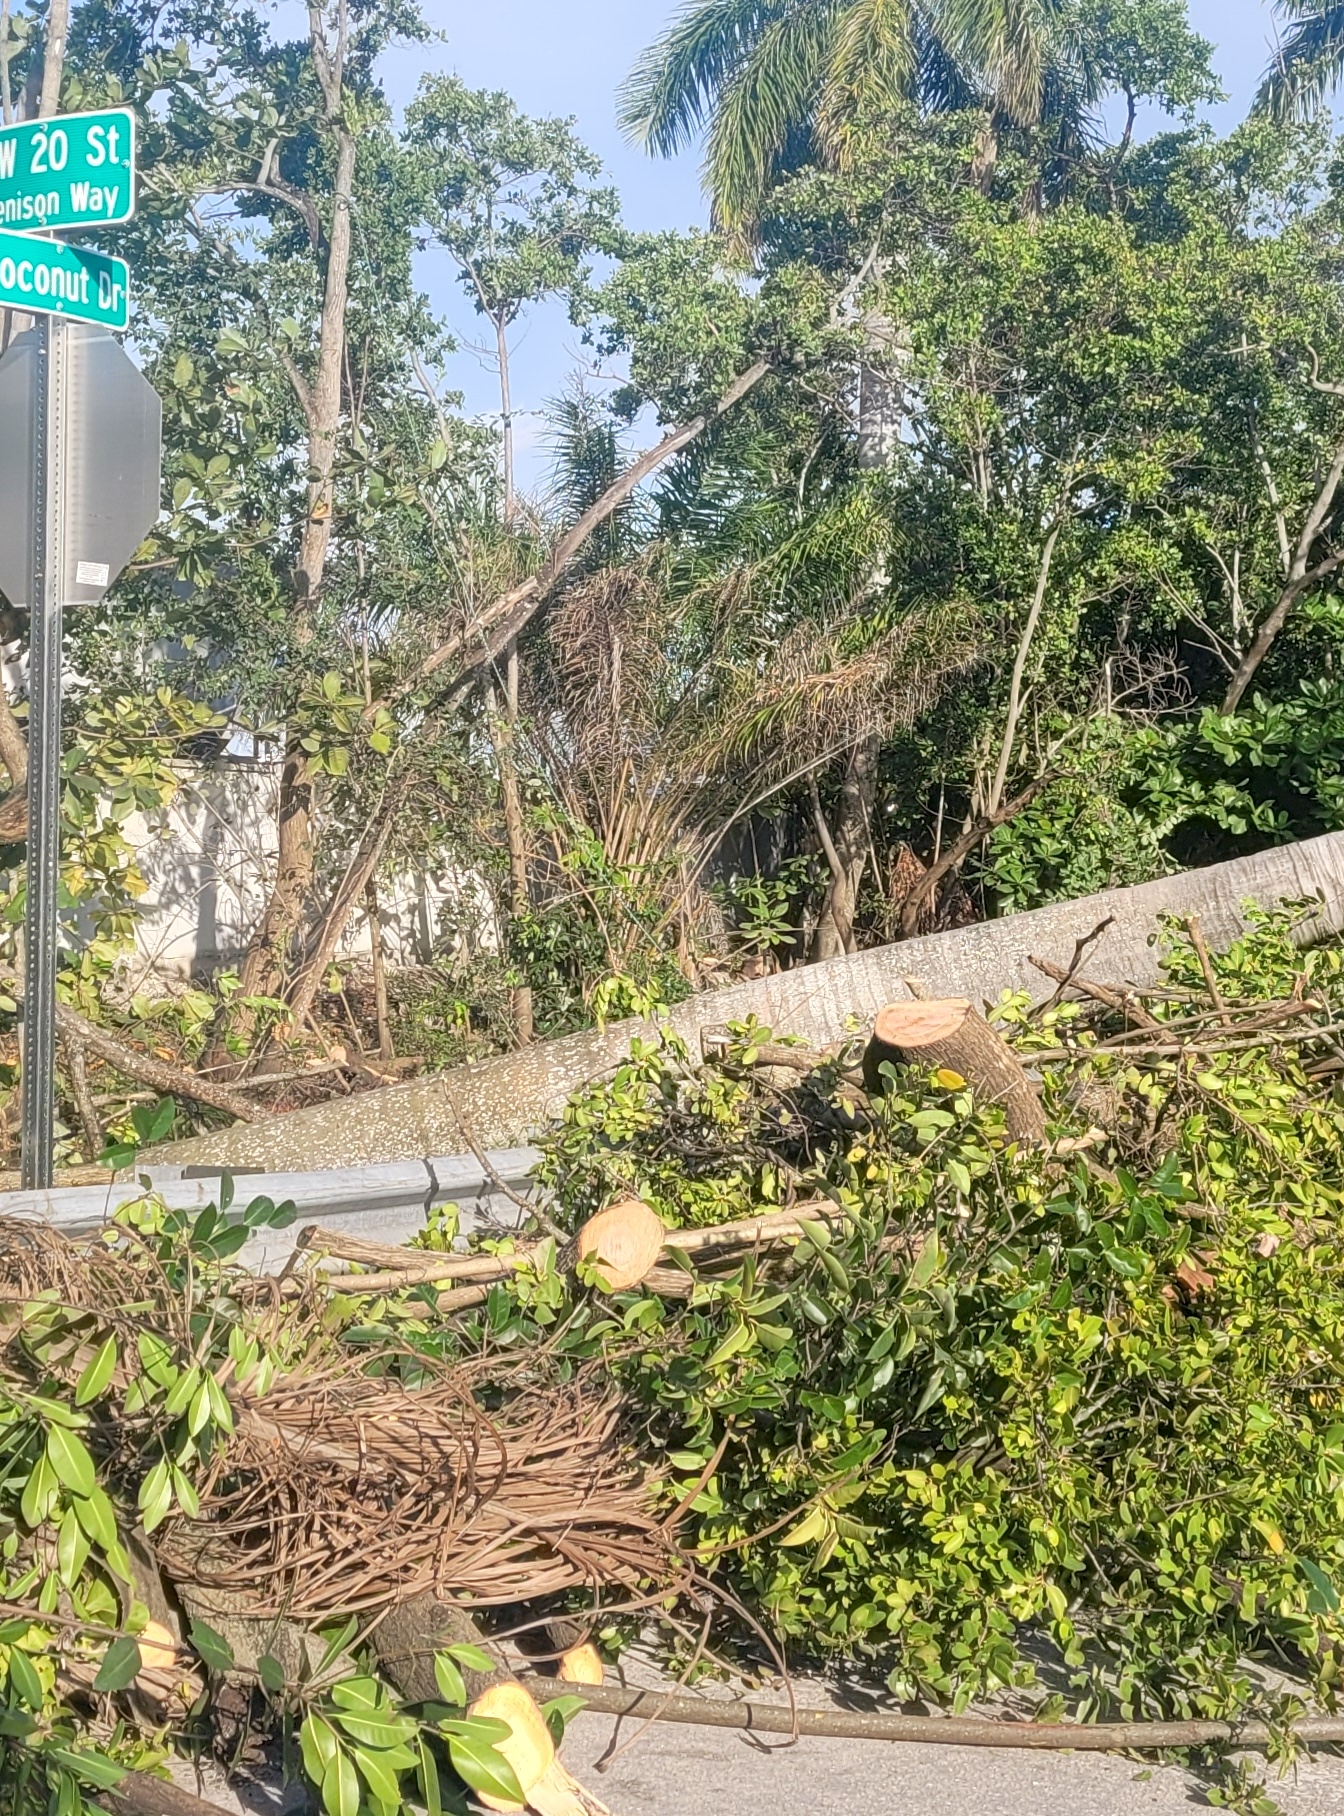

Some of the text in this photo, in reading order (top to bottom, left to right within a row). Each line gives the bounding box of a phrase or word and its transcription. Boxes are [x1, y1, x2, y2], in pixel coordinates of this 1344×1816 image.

[30, 129, 68, 174] 20
[86, 124, 120, 167] St
[70, 181, 120, 218] Way
[98, 270, 122, 312] Dr
